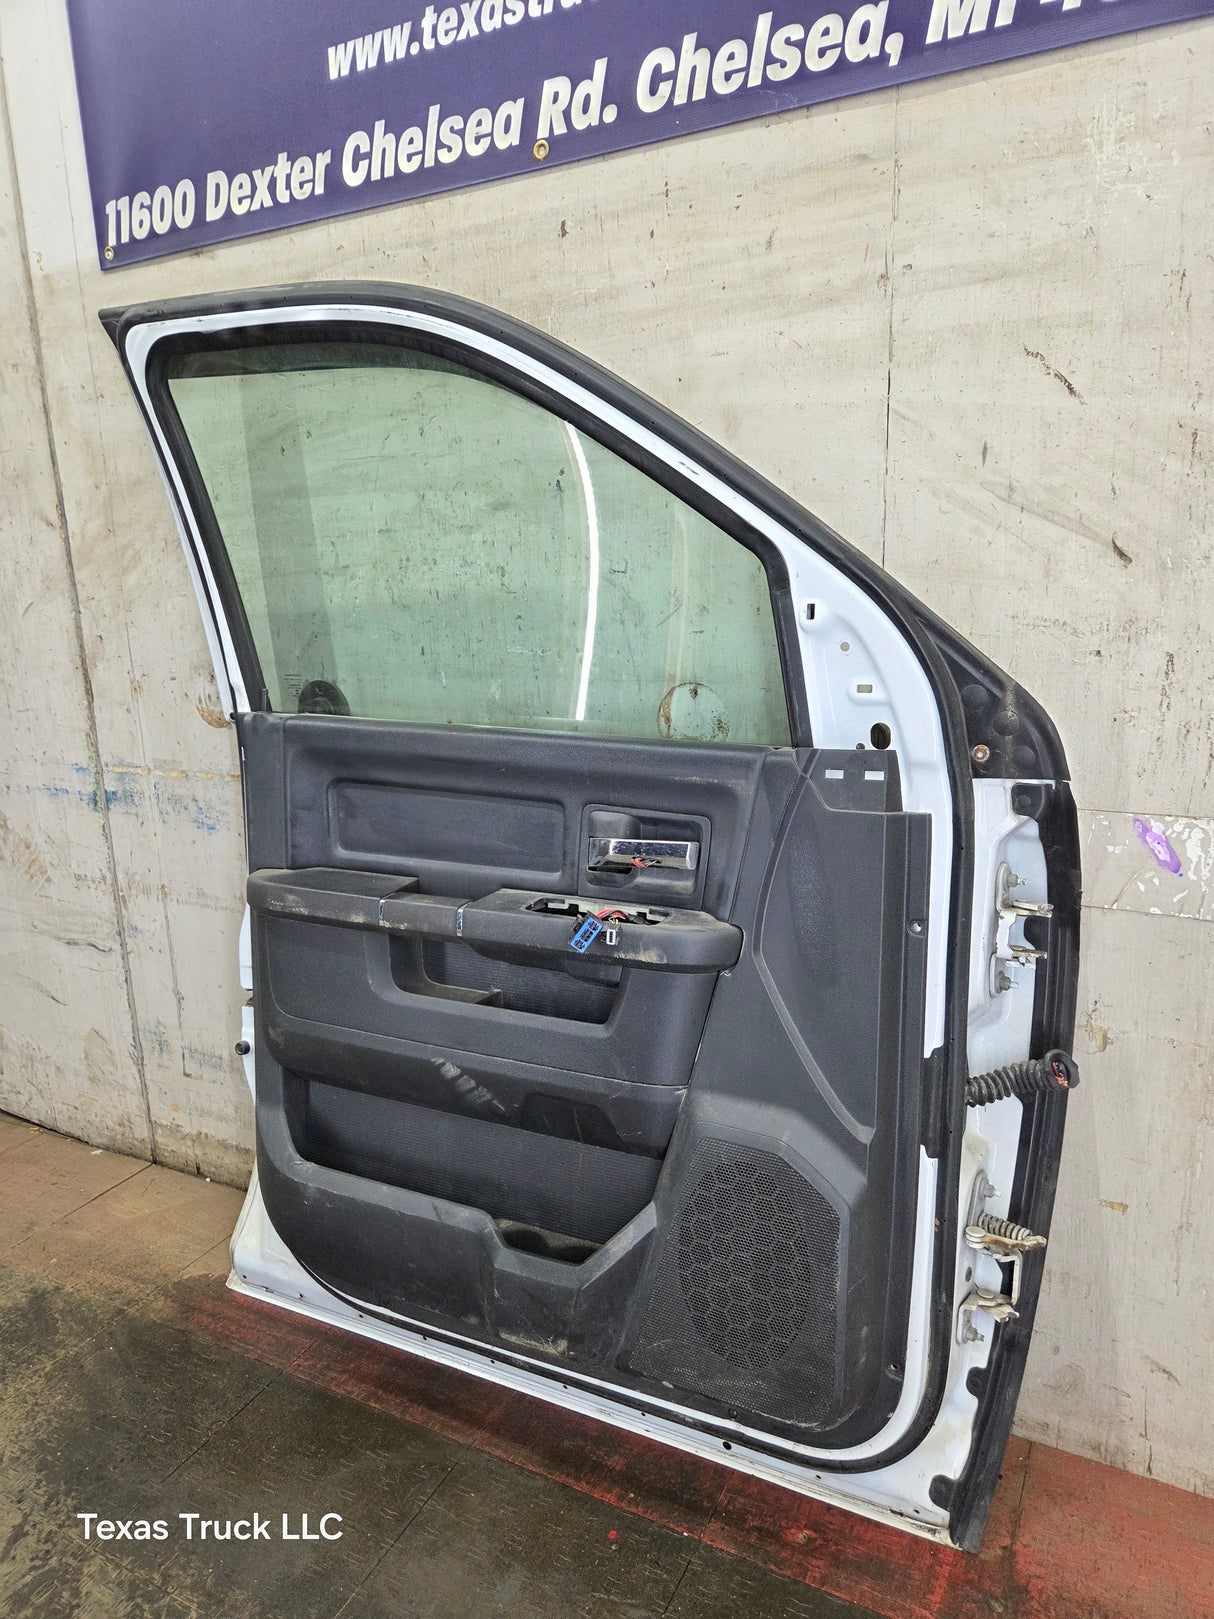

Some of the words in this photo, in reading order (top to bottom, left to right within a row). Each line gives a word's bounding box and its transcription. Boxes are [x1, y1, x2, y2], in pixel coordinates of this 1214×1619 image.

[327, 0, 583, 81] www.texas
[105, 178, 196, 247] 11600
[206, 149, 332, 223] Dexter
[341, 97, 525, 188] Chelsea
[536, 56, 618, 140] Rd.
[636, 0, 904, 113] Chelsea,
